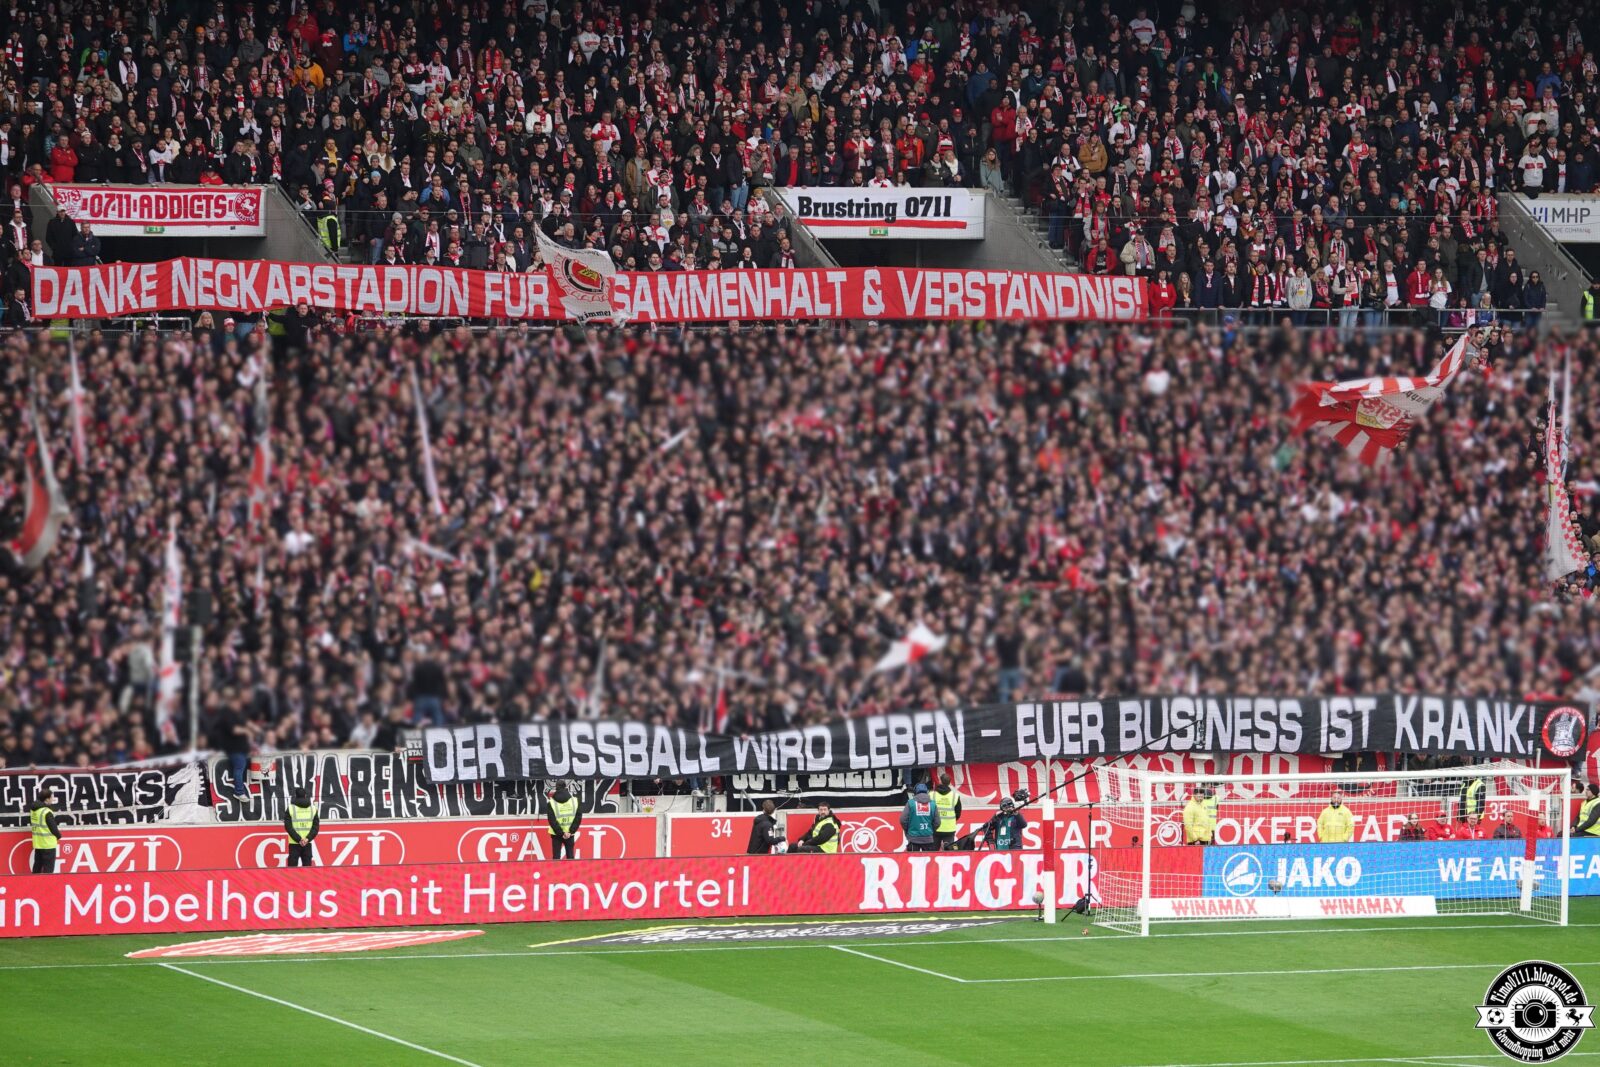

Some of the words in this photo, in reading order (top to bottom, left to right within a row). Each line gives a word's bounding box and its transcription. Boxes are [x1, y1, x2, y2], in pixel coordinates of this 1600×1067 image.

[798, 195, 898, 223] Brustring
[905, 195, 952, 217] 0711
[1552, 207, 1591, 223] MHP
[34, 263, 158, 316] DANKE
[171, 258, 470, 316] NECKARSTADION
[484, 272, 550, 318] FÜR
[862, 269, 886, 316] &
[896, 270, 1142, 319] VERSTÄNDNIS!
[425, 724, 505, 782] DER
[518, 721, 720, 777] FUSSBALL
[733, 725, 833, 772] WIRD
[846, 709, 965, 770] LEBEN
[1016, 701, 1105, 757] EUER
[1119, 698, 1303, 753] BUSINESS
[1319, 697, 1376, 752] IST
[1394, 696, 1536, 755] KRANK!
[711, 818, 732, 838] 34
[859, 853, 1099, 909] RIEGER
[1276, 857, 1362, 888] JAKO
[1438, 857, 1481, 882] WE
[64, 879, 339, 925] Möbelhaus
[360, 875, 442, 917] mit
[464, 866, 750, 914] Heimvorteil
[1171, 899, 1259, 916] WINAMAX
[1319, 898, 1406, 915] WINAMAX
